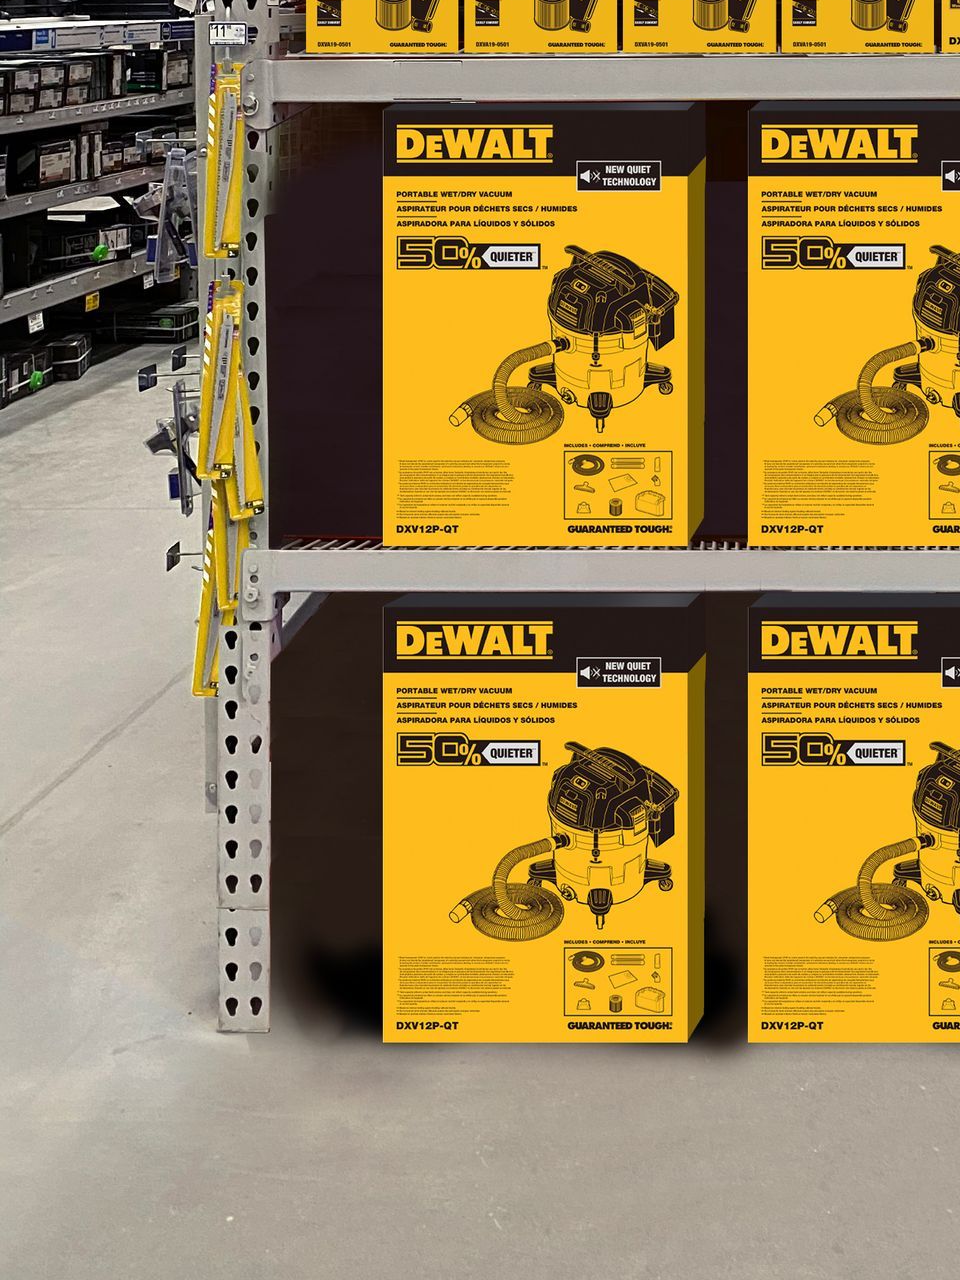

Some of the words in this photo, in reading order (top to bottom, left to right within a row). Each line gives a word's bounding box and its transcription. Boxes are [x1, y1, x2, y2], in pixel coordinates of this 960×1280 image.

[606, 165, 625, 174] NEW
[627, 165, 652, 175] QUIET
[602, 177, 657, 187] TECHNOLOGY
[396, 190, 438, 198] PORTABLE
[440, 190, 476, 198] WET/DRY
[479, 190, 513, 198] VACUUM
[396, 205, 447, 213] ASPIRATEUR
[449, 205, 472, 213] POUR
[513, 205, 534, 213] SECS
[541, 205, 578, 213] HUMIDES
[396, 220, 448, 228] ASPIRADORA
[397, 236, 482, 270] 50%
[490, 251, 534, 263] QUIETER
[762, 236, 847, 270] 50%
[855, 251, 899, 263] QUIETER
[396, 525, 460, 534] DXV12P-QT
[567, 525, 633, 534] GUARANTEED
[761, 525, 825, 534] DXV12P-QT
[397, 733, 482, 767] 50%
[490, 748, 534, 760] QUIETER
[762, 733, 847, 767] 50%
[855, 748, 899, 760] QUIETER
[396, 1022, 460, 1031] DXV12P-QT
[761, 1022, 825, 1031] DXV12P-QT
